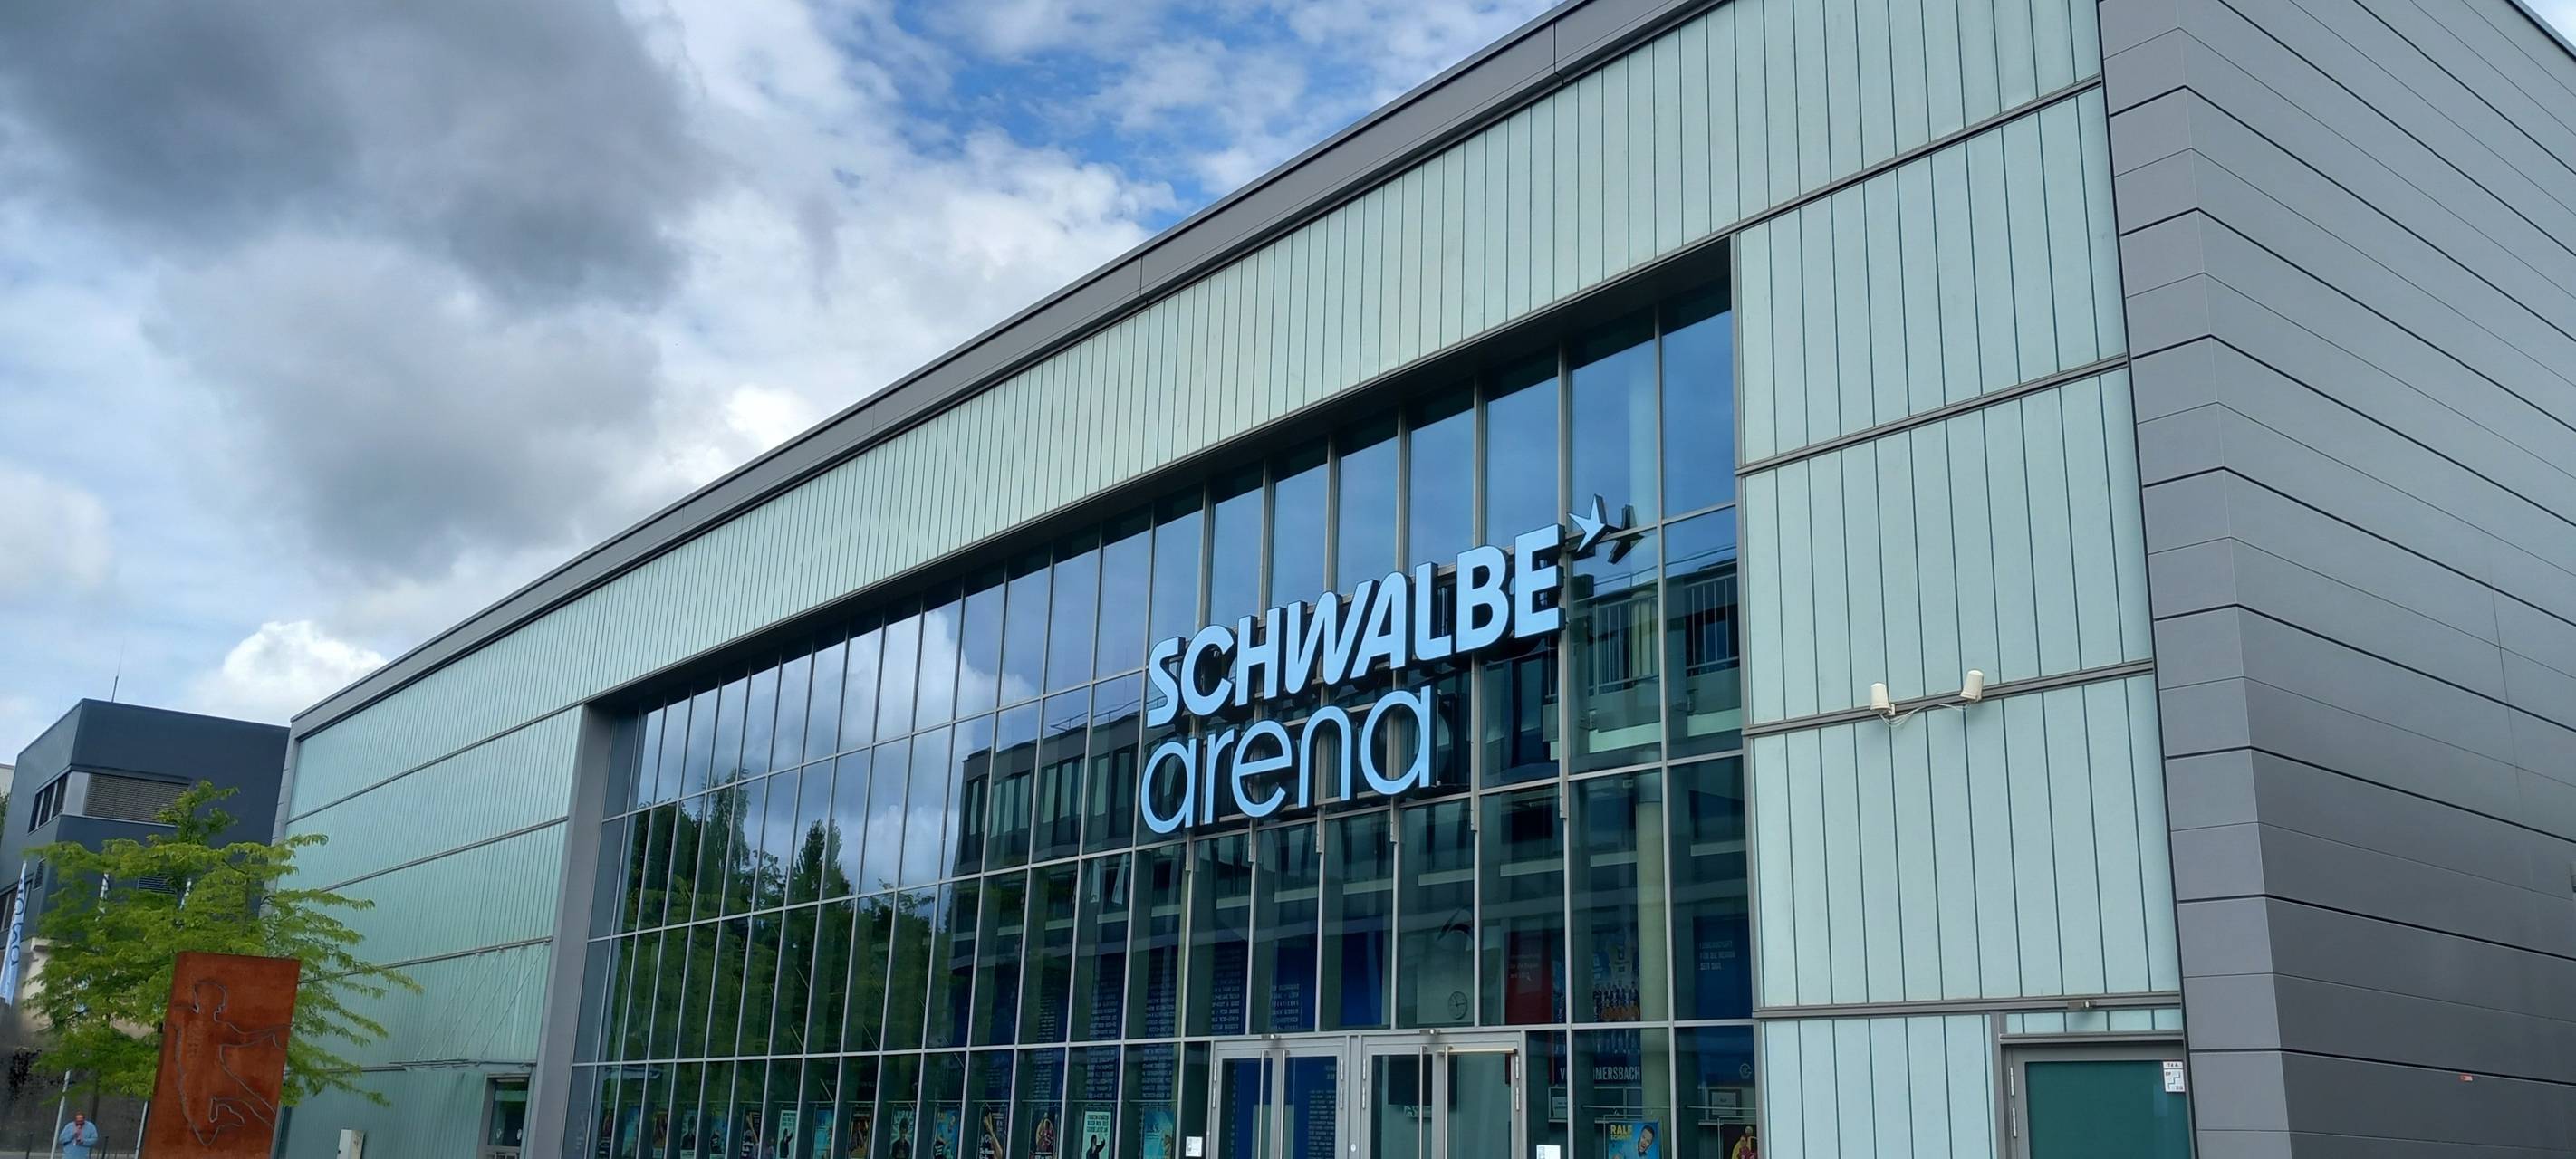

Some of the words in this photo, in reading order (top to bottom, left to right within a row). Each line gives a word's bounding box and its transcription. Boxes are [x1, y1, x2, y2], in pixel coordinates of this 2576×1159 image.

[1147, 523, 1565, 728] SCHWALBE
[1140, 685, 1436, 835] arena
[1593, 1065, 1641, 1081] MERSBACH
